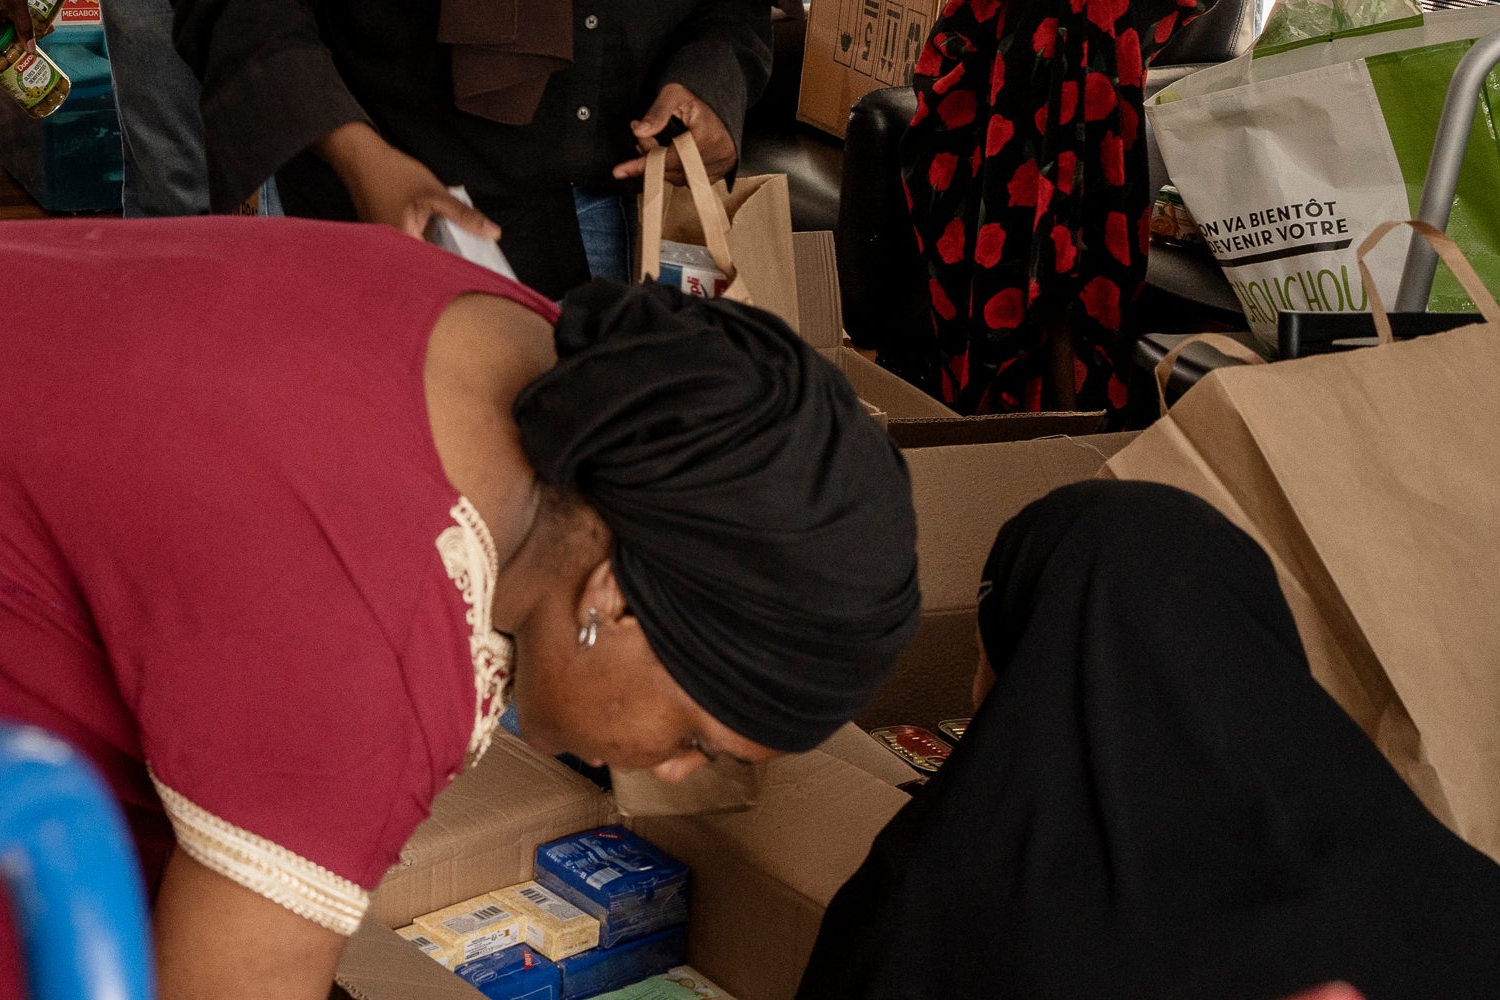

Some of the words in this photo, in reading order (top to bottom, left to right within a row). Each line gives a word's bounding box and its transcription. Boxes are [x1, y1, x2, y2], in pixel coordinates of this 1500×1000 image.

[62, 9, 100, 18] MEGABOX
[1223, 215, 1246, 233] VA
[1249, 198, 1337, 228] BIENTÔT
[1276, 218, 1349, 242] VOTRE
